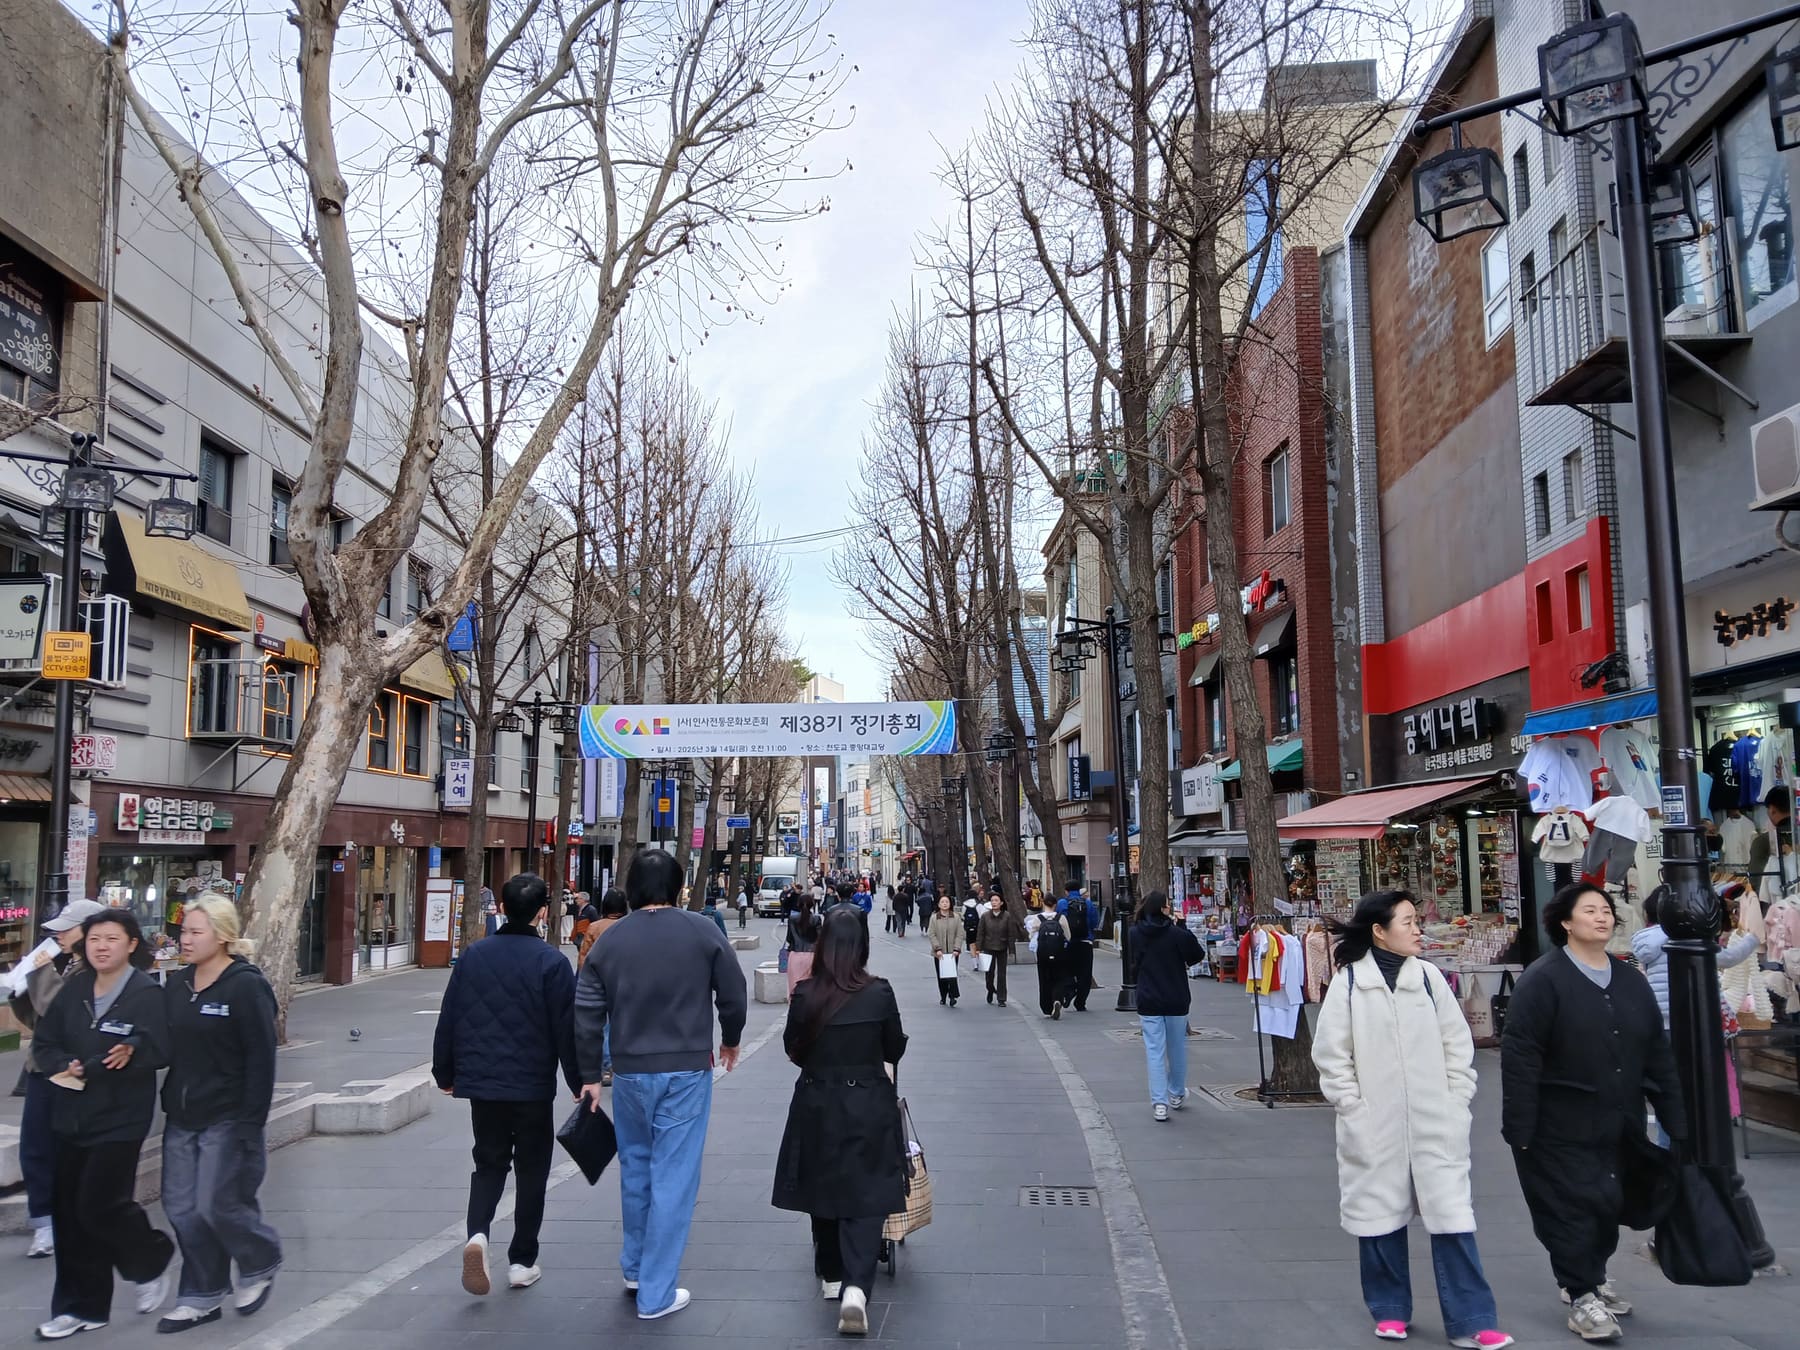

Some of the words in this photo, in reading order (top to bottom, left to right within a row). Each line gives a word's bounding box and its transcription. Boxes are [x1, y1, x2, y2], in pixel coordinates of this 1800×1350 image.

[5, 628, 36, 640] 오가다
[780, 714, 843, 734] 제38기
[850, 713, 922, 736] 정기총회
[1403, 696, 1479, 756] 공예나라
[720, 745, 748, 753] 14일(금)
[766, 744, 788, 752] 11:00
[451, 761, 470, 770] 만곡
[453, 773, 466, 798] 서예
